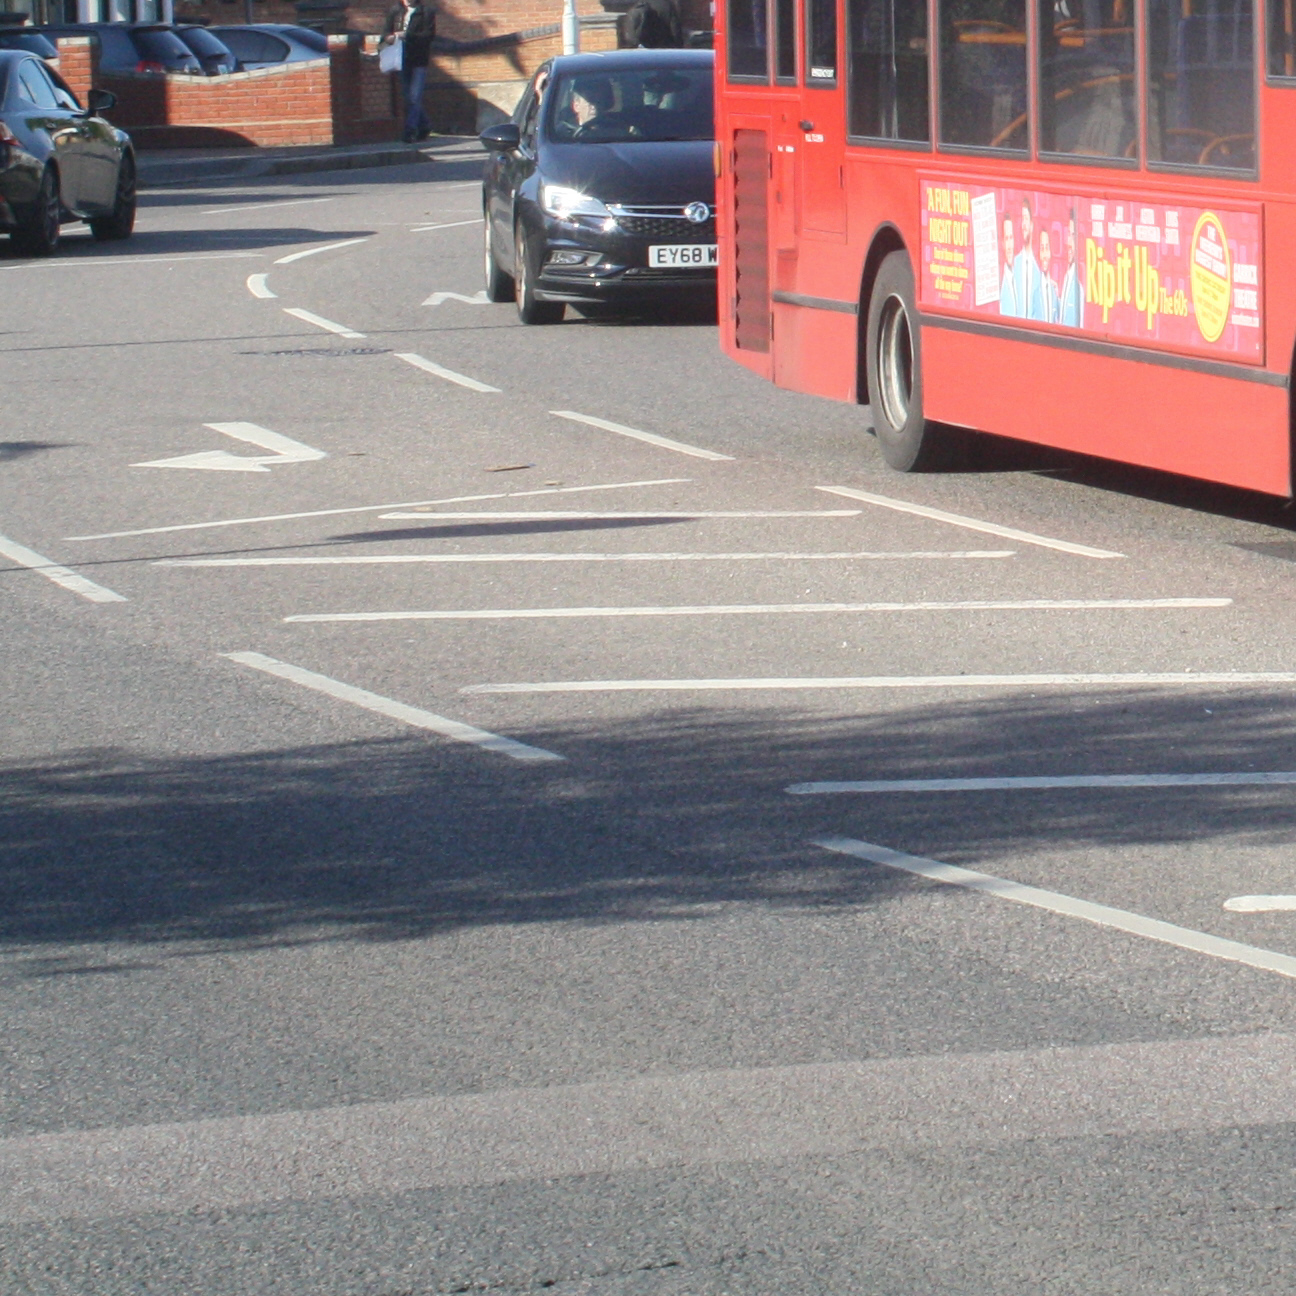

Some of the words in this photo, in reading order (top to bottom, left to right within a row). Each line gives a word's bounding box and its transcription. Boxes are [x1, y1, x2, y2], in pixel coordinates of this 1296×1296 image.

[953, 190, 970, 217] FUN
[929, 217, 952, 245] NIGHT
[953, 220, 969, 247] OUT
[657, 247, 703, 264] EY68
[1085, 237, 1115, 324] Rip
[1116, 242, 1132, 304] it
[1133, 245, 1159, 331] Up
[1159, 287, 1174, 315] The
